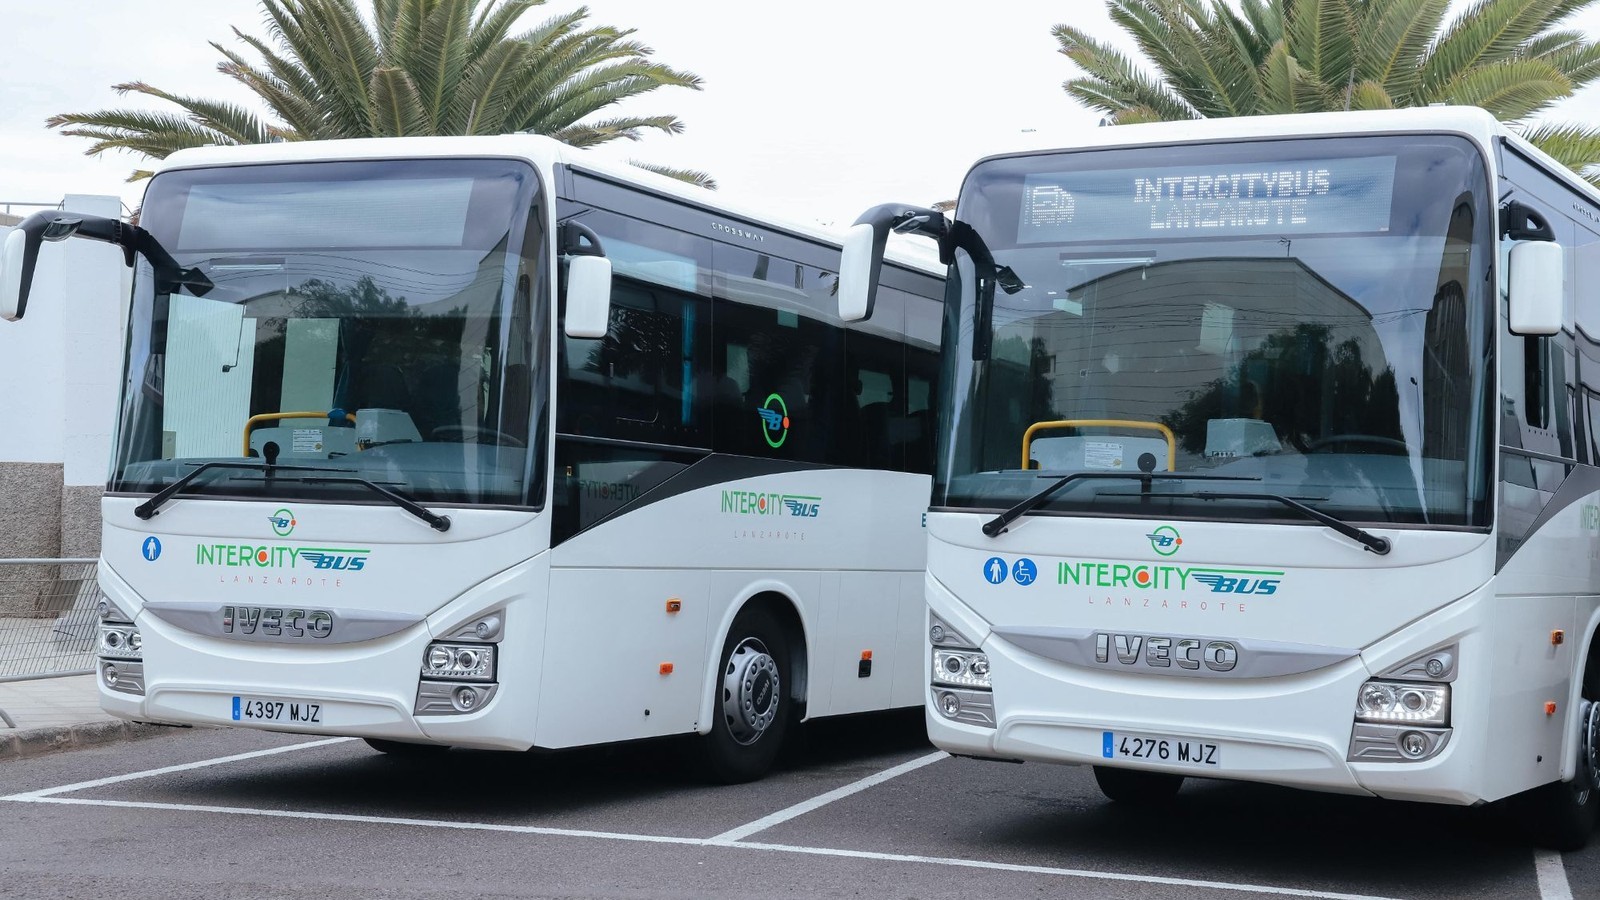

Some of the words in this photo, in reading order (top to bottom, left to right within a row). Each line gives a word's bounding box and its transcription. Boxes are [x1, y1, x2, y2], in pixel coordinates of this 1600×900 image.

[1133, 169, 1331, 203] INTERCITYBUS
[1150, 199, 1307, 229] LANZAROTE
[711, 222, 764, 242] CROSSWAY
[721, 490, 784, 516] INTERCITY
[790, 501, 820, 517] BUS
[734, 530, 805, 541] LANZAROTE
[196, 544, 300, 569] INTERCITY
[313, 553, 367, 571] BUS
[220, 575, 342, 587] LANZAROTE
[1057, 562, 1190, 590] INTERCITY
[1210, 576, 1281, 595] BUS
[1088, 596, 1245, 612] LANZAROTE
[223, 606, 333, 639] IVECO
[1096, 633, 1238, 672] IVECO
[245, 701, 284, 719] 4397
[290, 703, 320, 722] MJZ
[1119, 737, 1170, 760] 4276
[1177, 741, 1217, 765] MJZ
